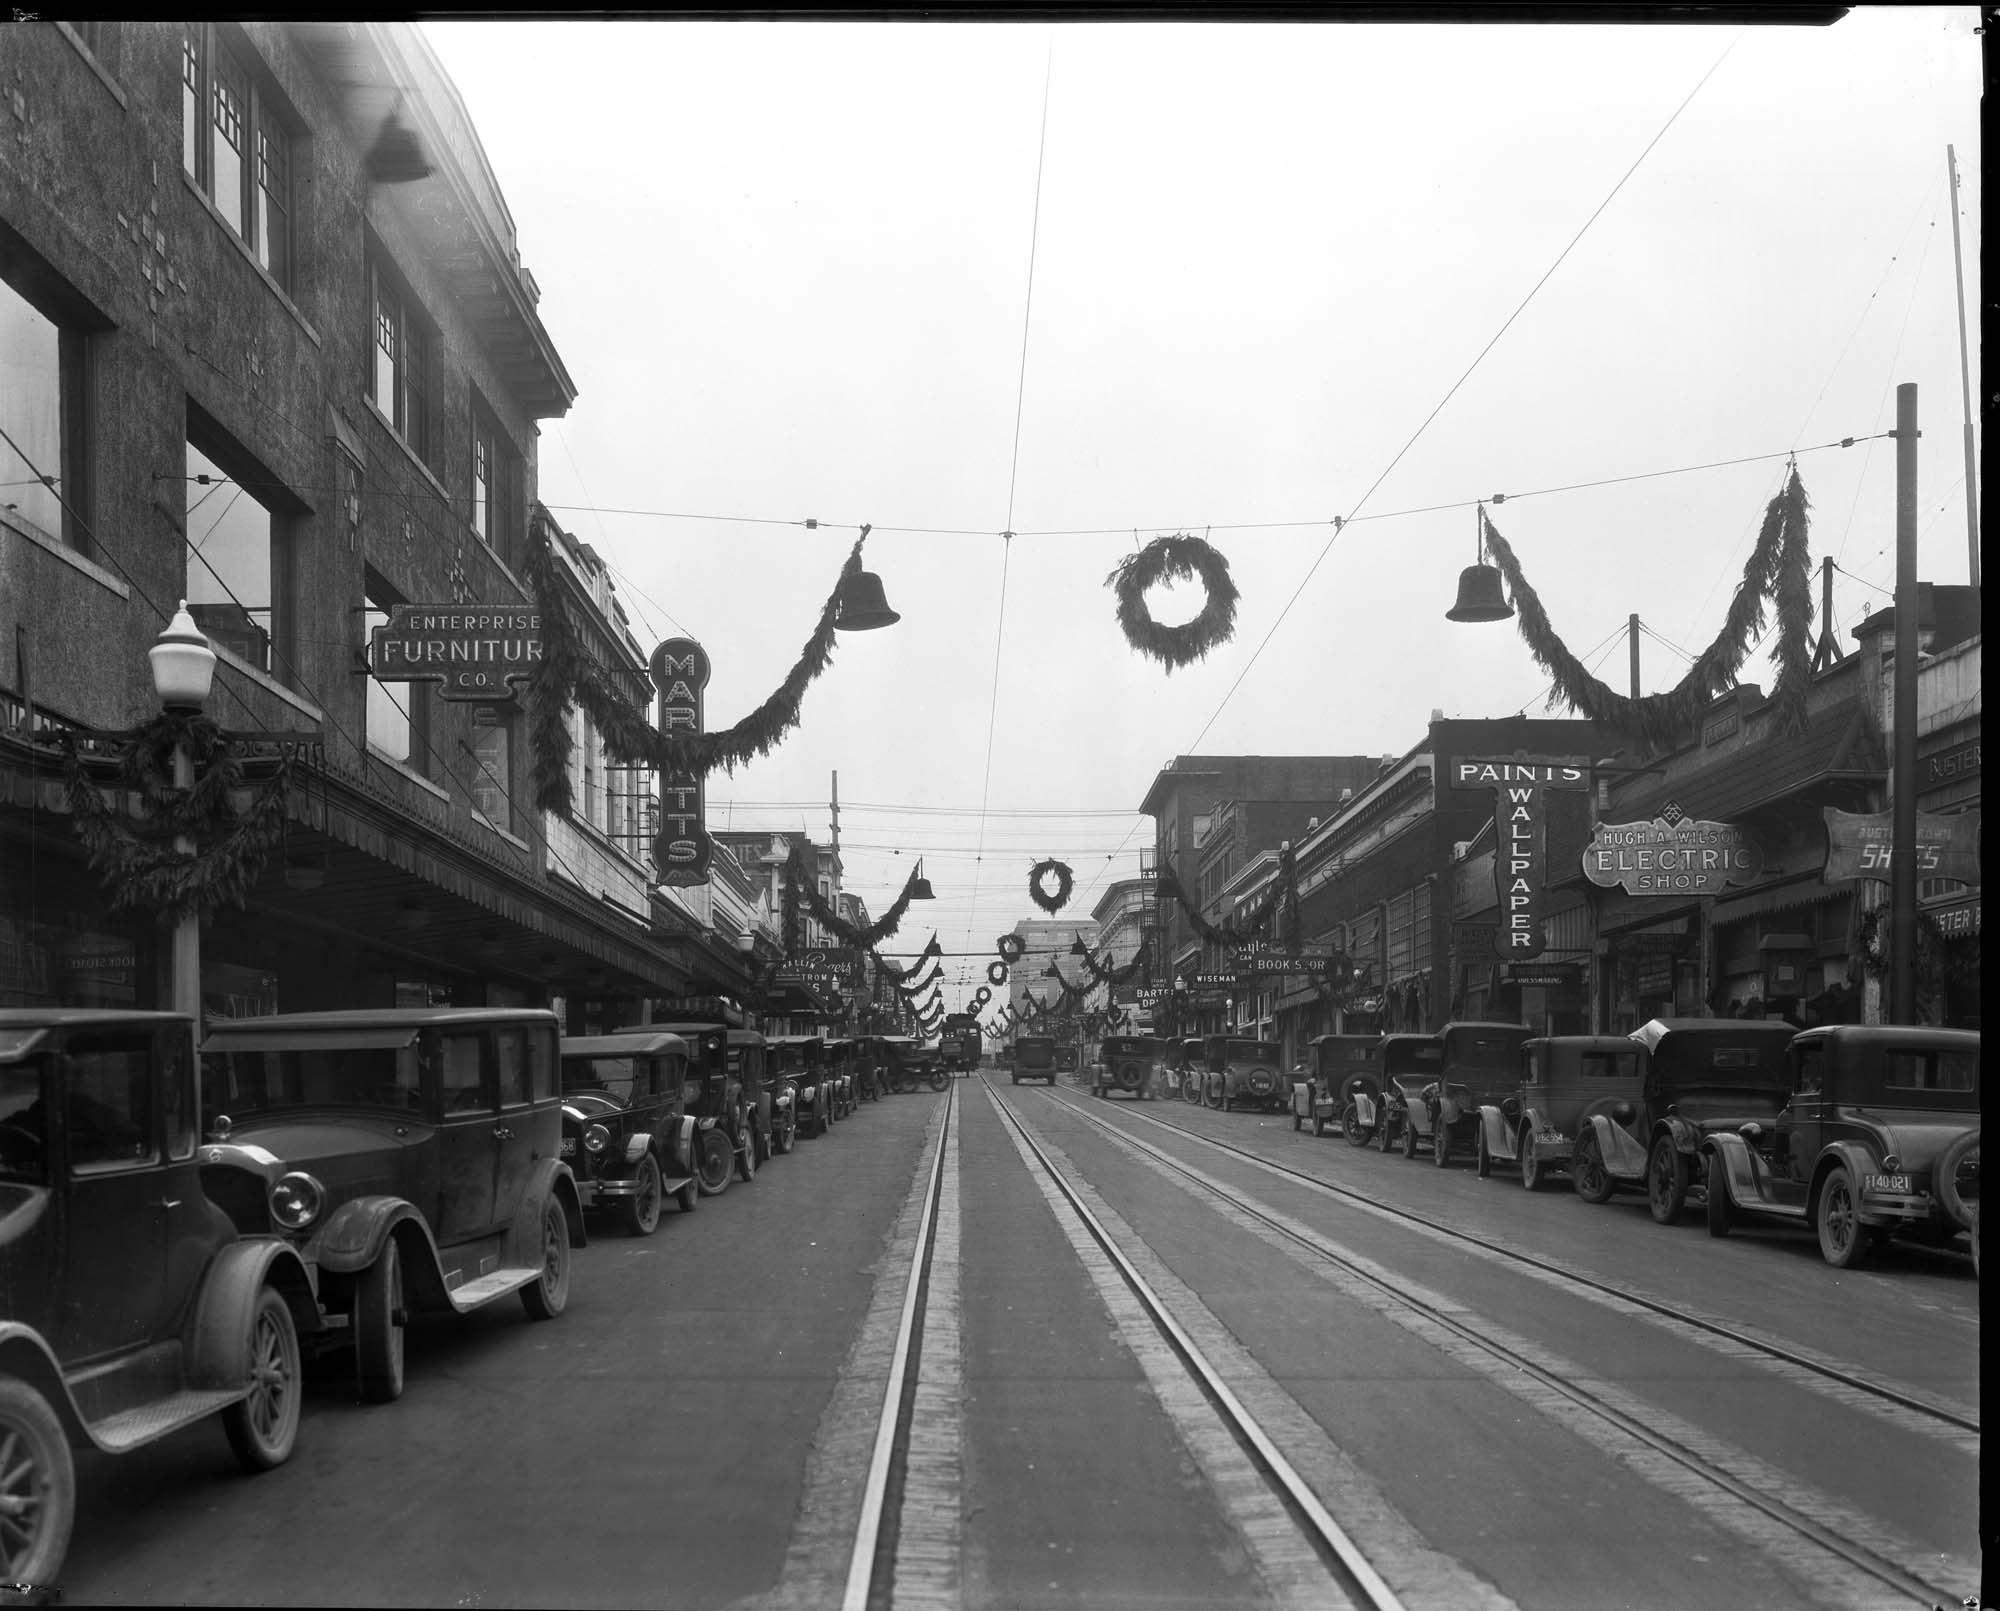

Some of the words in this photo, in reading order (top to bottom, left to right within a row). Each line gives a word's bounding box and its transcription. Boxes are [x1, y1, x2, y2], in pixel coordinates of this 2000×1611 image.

[410, 615, 541, 629] ENTERPRISE
[384, 639, 544, 662] FURNITUR
[459, 672, 495, 687] CO.
[664, 654, 697, 863] MARATTS
[1604, 831, 1646, 845] HUGH
[1656, 831, 1666, 843] A
[1678, 830, 1744, 844] WILSON
[1597, 849, 1750, 871] ELECTRIC
[1859, 844, 1943, 869] SHES
[1508, 788, 1533, 947] WALLPAPER
[1639, 874, 1708, 889] SHOP
[1257, 959, 1290, 970] BOOK
[1294, 959, 1325, 970] SOR
[1196, 975, 1236, 983] WISEMAN
